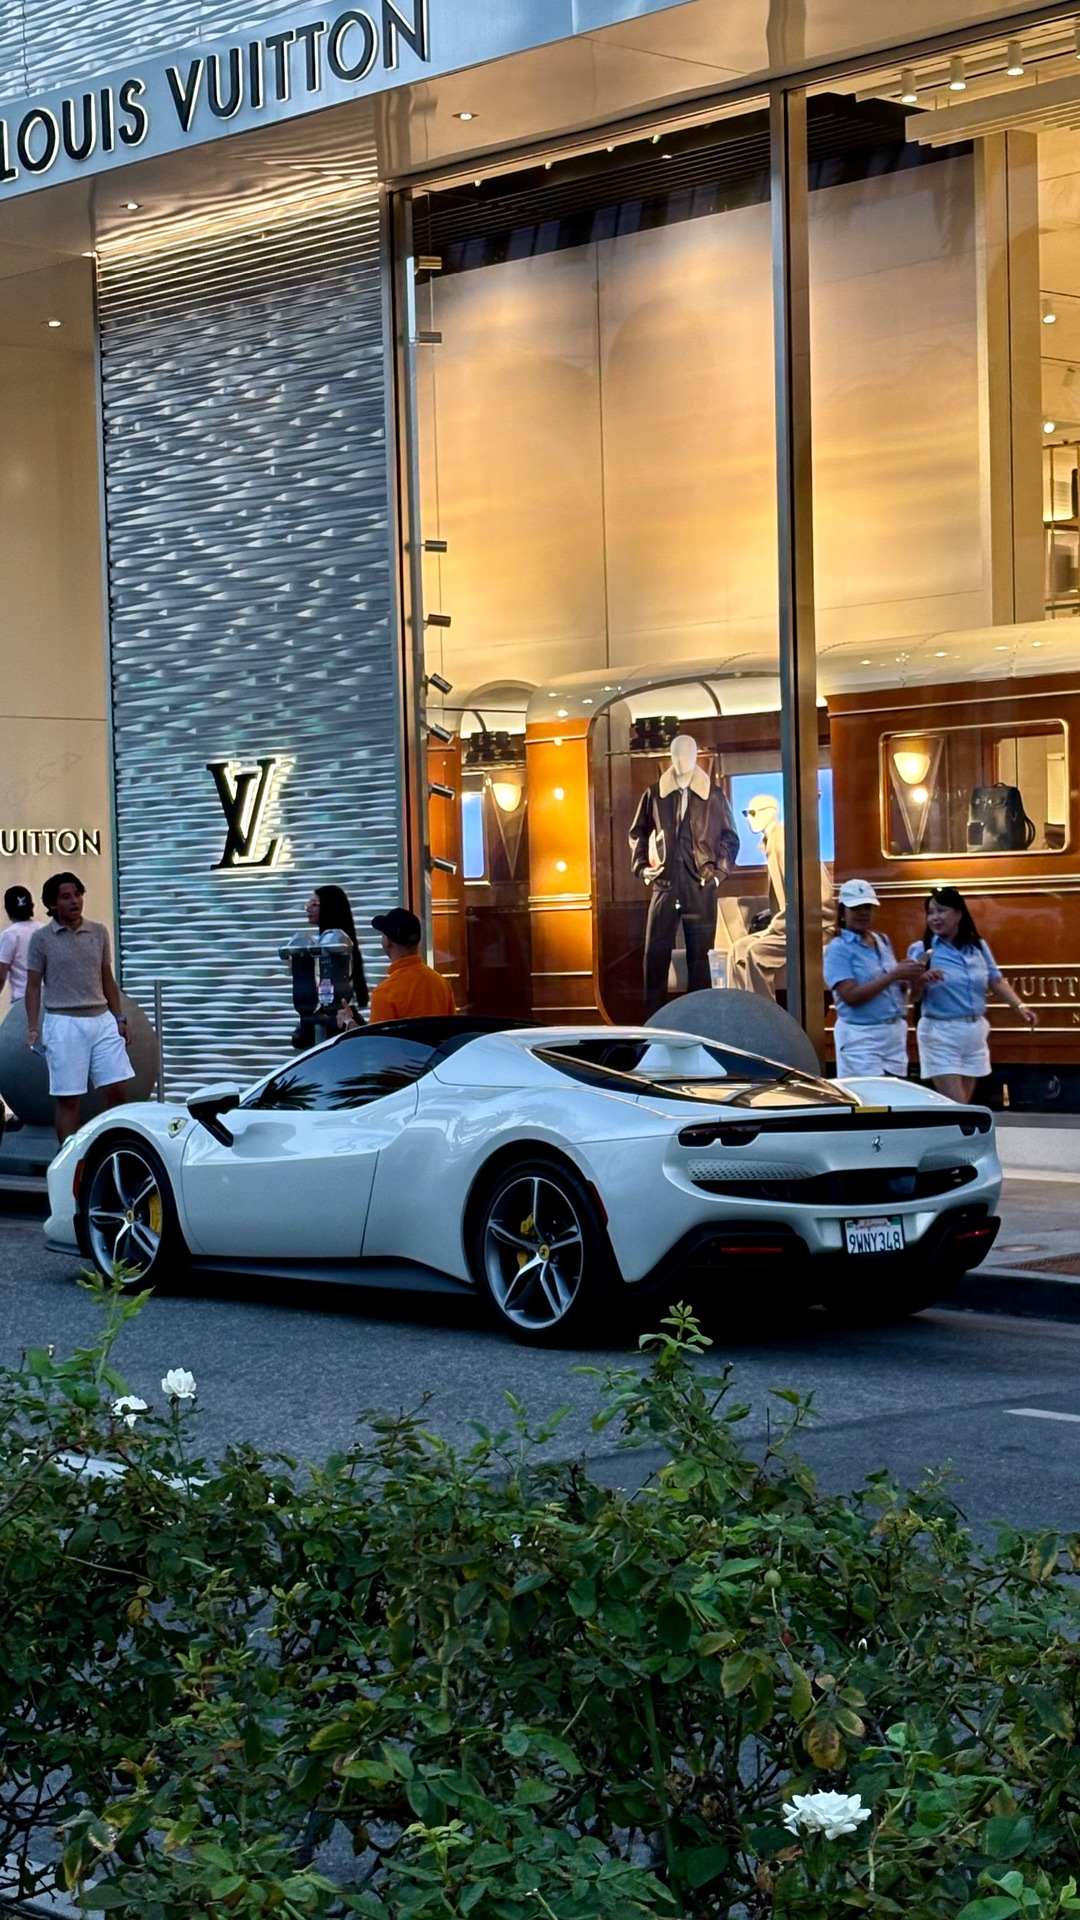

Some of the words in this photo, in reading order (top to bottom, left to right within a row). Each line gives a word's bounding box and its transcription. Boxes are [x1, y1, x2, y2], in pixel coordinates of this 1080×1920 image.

[0, 78, 149, 183] LOUIS
[165, 0, 430, 133] VUITTON
[0, 828, 101, 856] UITTON
[848, 1231, 901, 1253] 9WNY348
